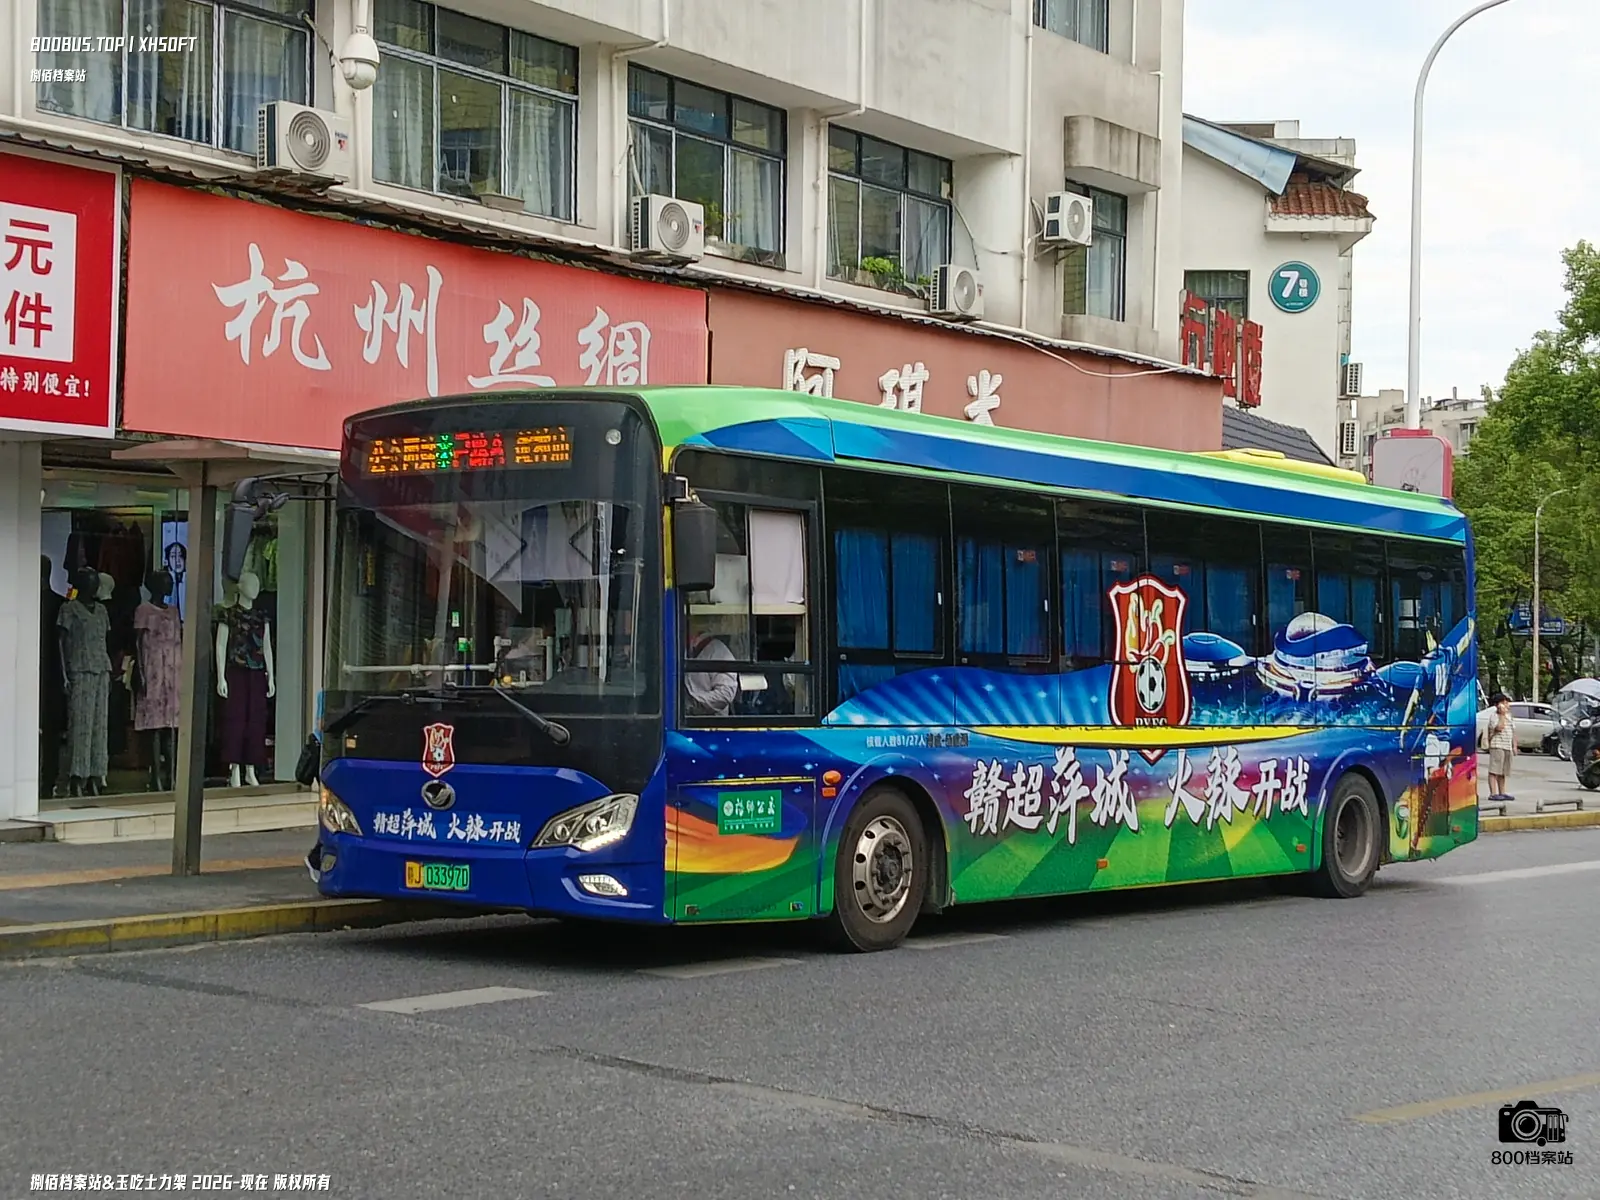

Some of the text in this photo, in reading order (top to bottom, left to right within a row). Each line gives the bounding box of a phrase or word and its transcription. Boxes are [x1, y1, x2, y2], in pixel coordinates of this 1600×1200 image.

[211, 243, 651, 397] 杭州丝绸
[446, 812, 521, 844] 火辣开战
[964, 746, 1310, 844] 赣超萍城 火辣开战
